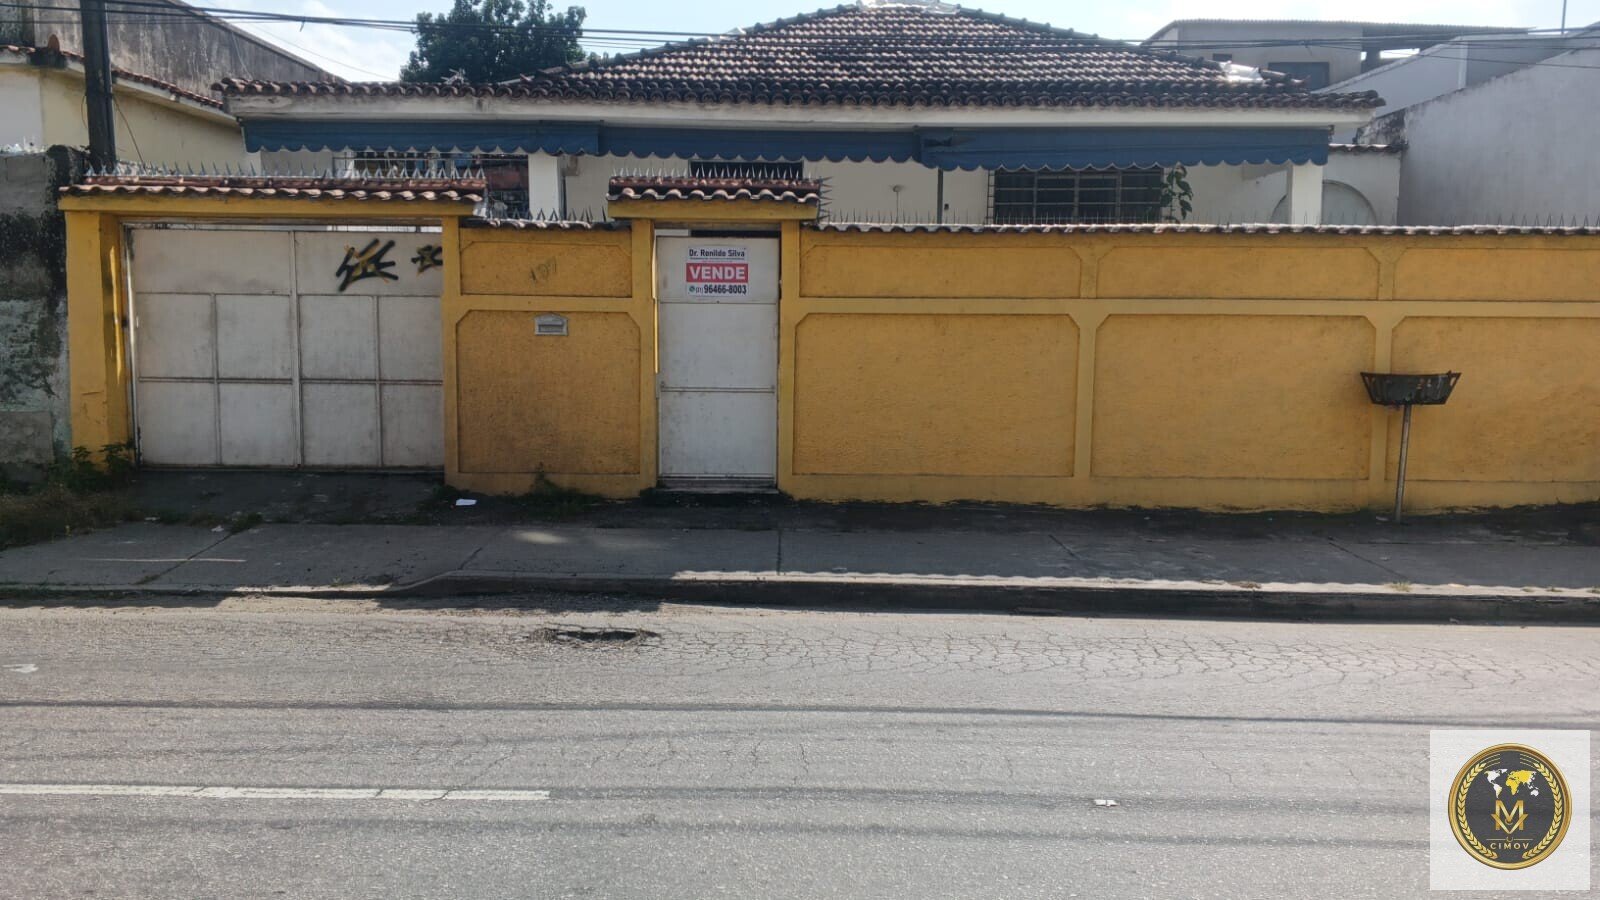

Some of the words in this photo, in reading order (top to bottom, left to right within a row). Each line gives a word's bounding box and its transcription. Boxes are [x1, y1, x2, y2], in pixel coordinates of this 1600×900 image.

[689, 249, 698, 257] Dr.
[700, 249, 727, 257] Ronildo
[727, 249, 745, 257] Silva
[689, 266, 746, 280] VENDE
[703, 284, 747, 295] 96466-8003
